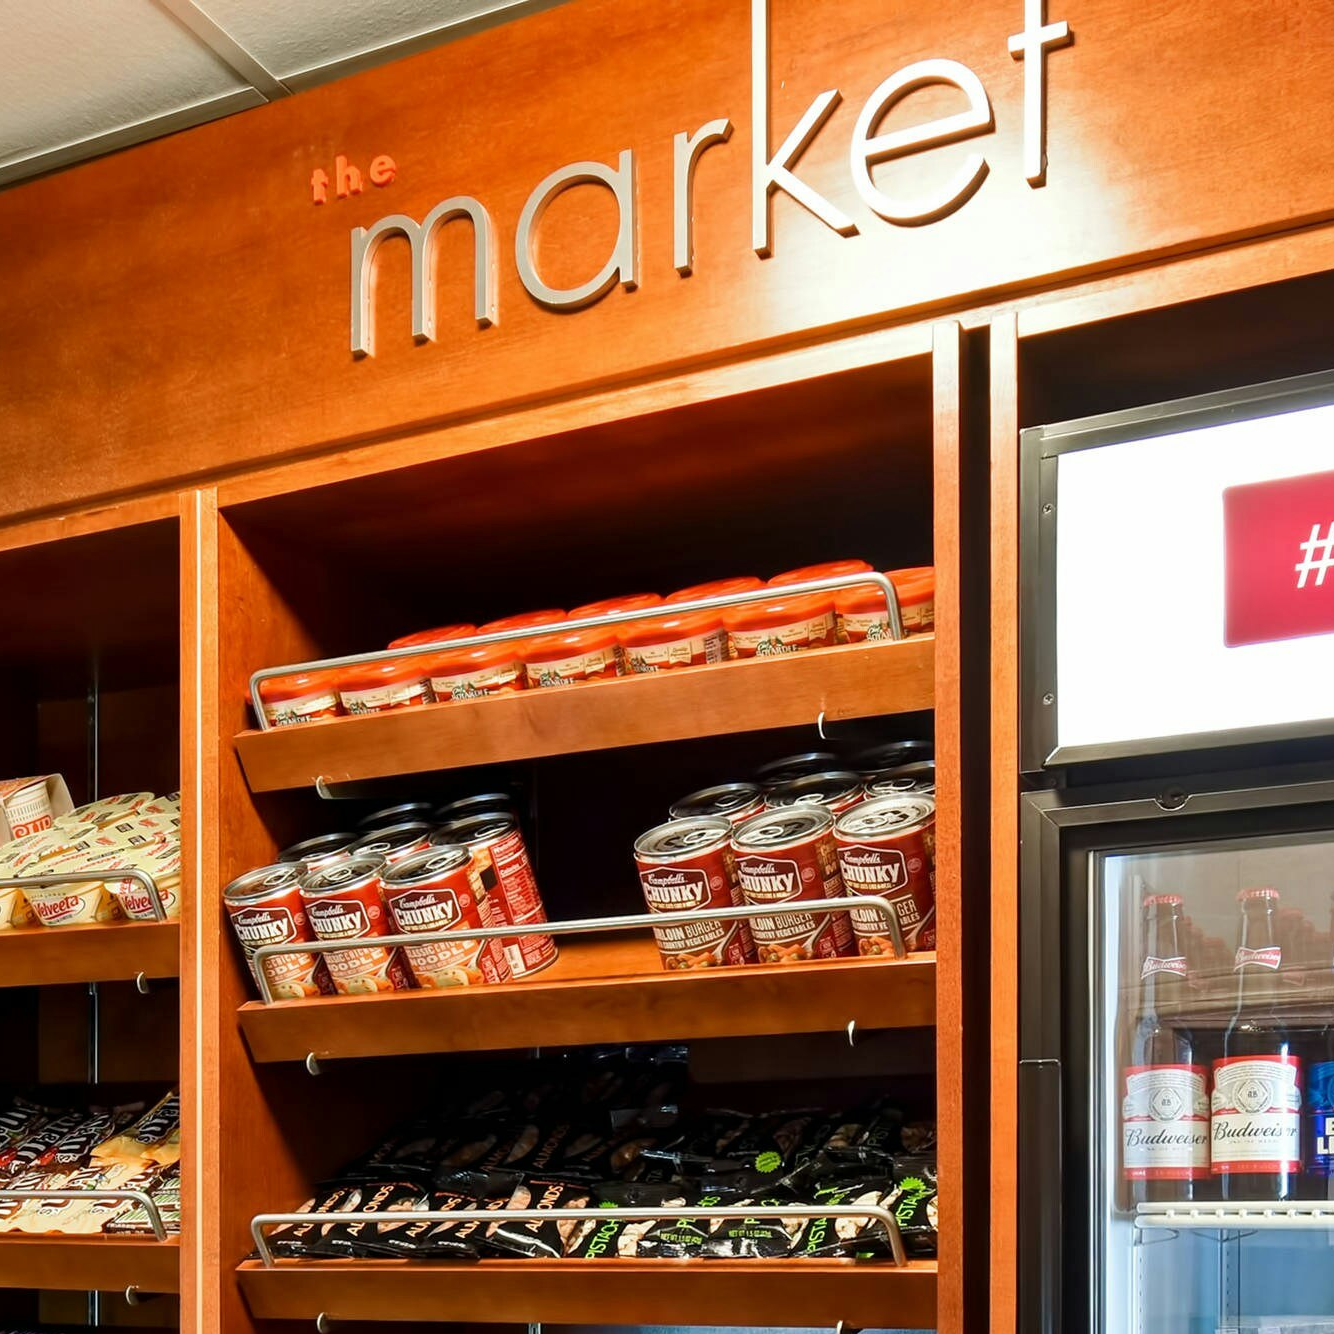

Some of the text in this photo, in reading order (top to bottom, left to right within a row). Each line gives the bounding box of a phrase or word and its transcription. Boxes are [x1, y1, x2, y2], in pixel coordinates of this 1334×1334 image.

[311, 151, 398, 205] the
[350, 0, 1072, 357] market
[737, 871, 793, 893] CHUNKY
[841, 862, 899, 882] CHUNKY
[644, 881, 704, 903] CHUNKY
[310, 910, 362, 933] CHUNKY
[394, 901, 453, 926] CHUNKY
[235, 918, 288, 941] CHUNKY
[1126, 1128, 1208, 1147] Budweiser
